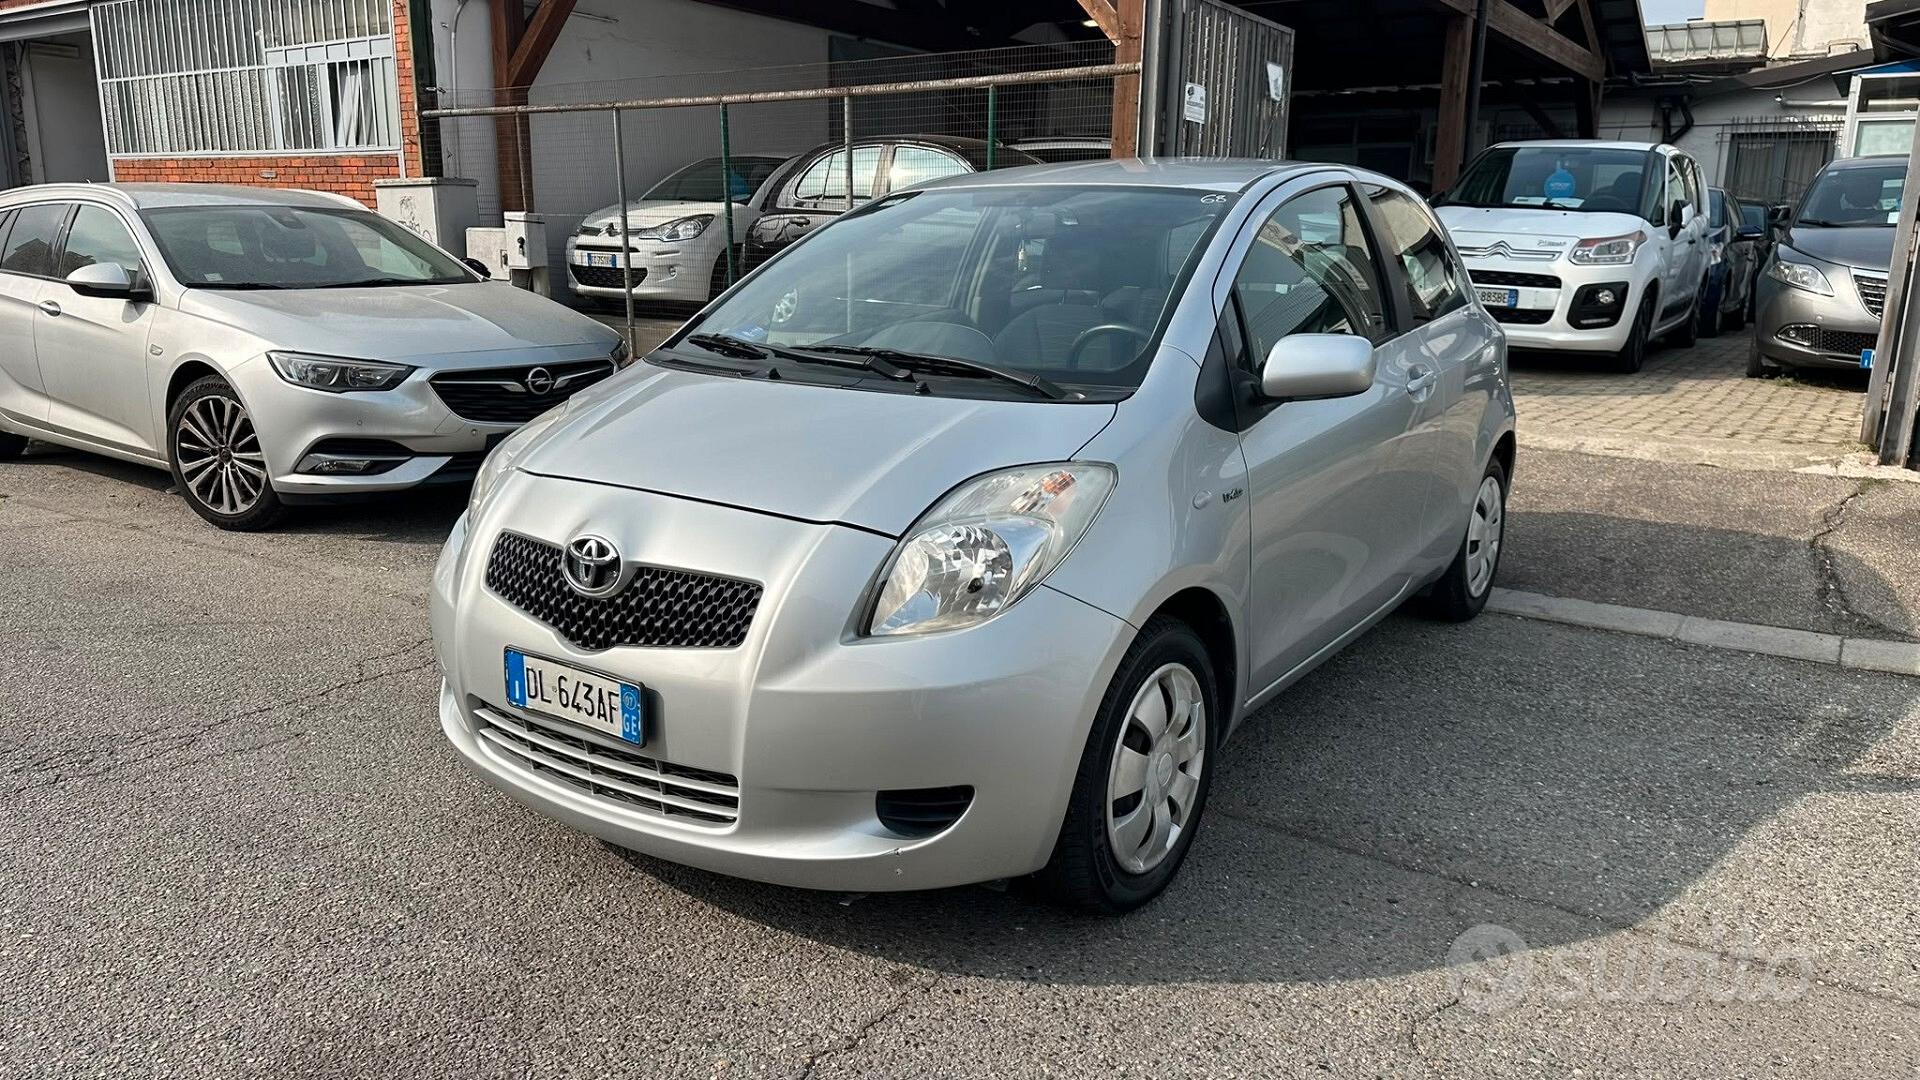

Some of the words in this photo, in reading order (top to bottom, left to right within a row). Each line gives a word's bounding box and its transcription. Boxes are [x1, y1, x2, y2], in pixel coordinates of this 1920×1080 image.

[1201, 194, 1227, 204] 68
[526, 667, 552, 704] DL
[558, 675, 619, 724] 643AF
[624, 713, 637, 736] GE
